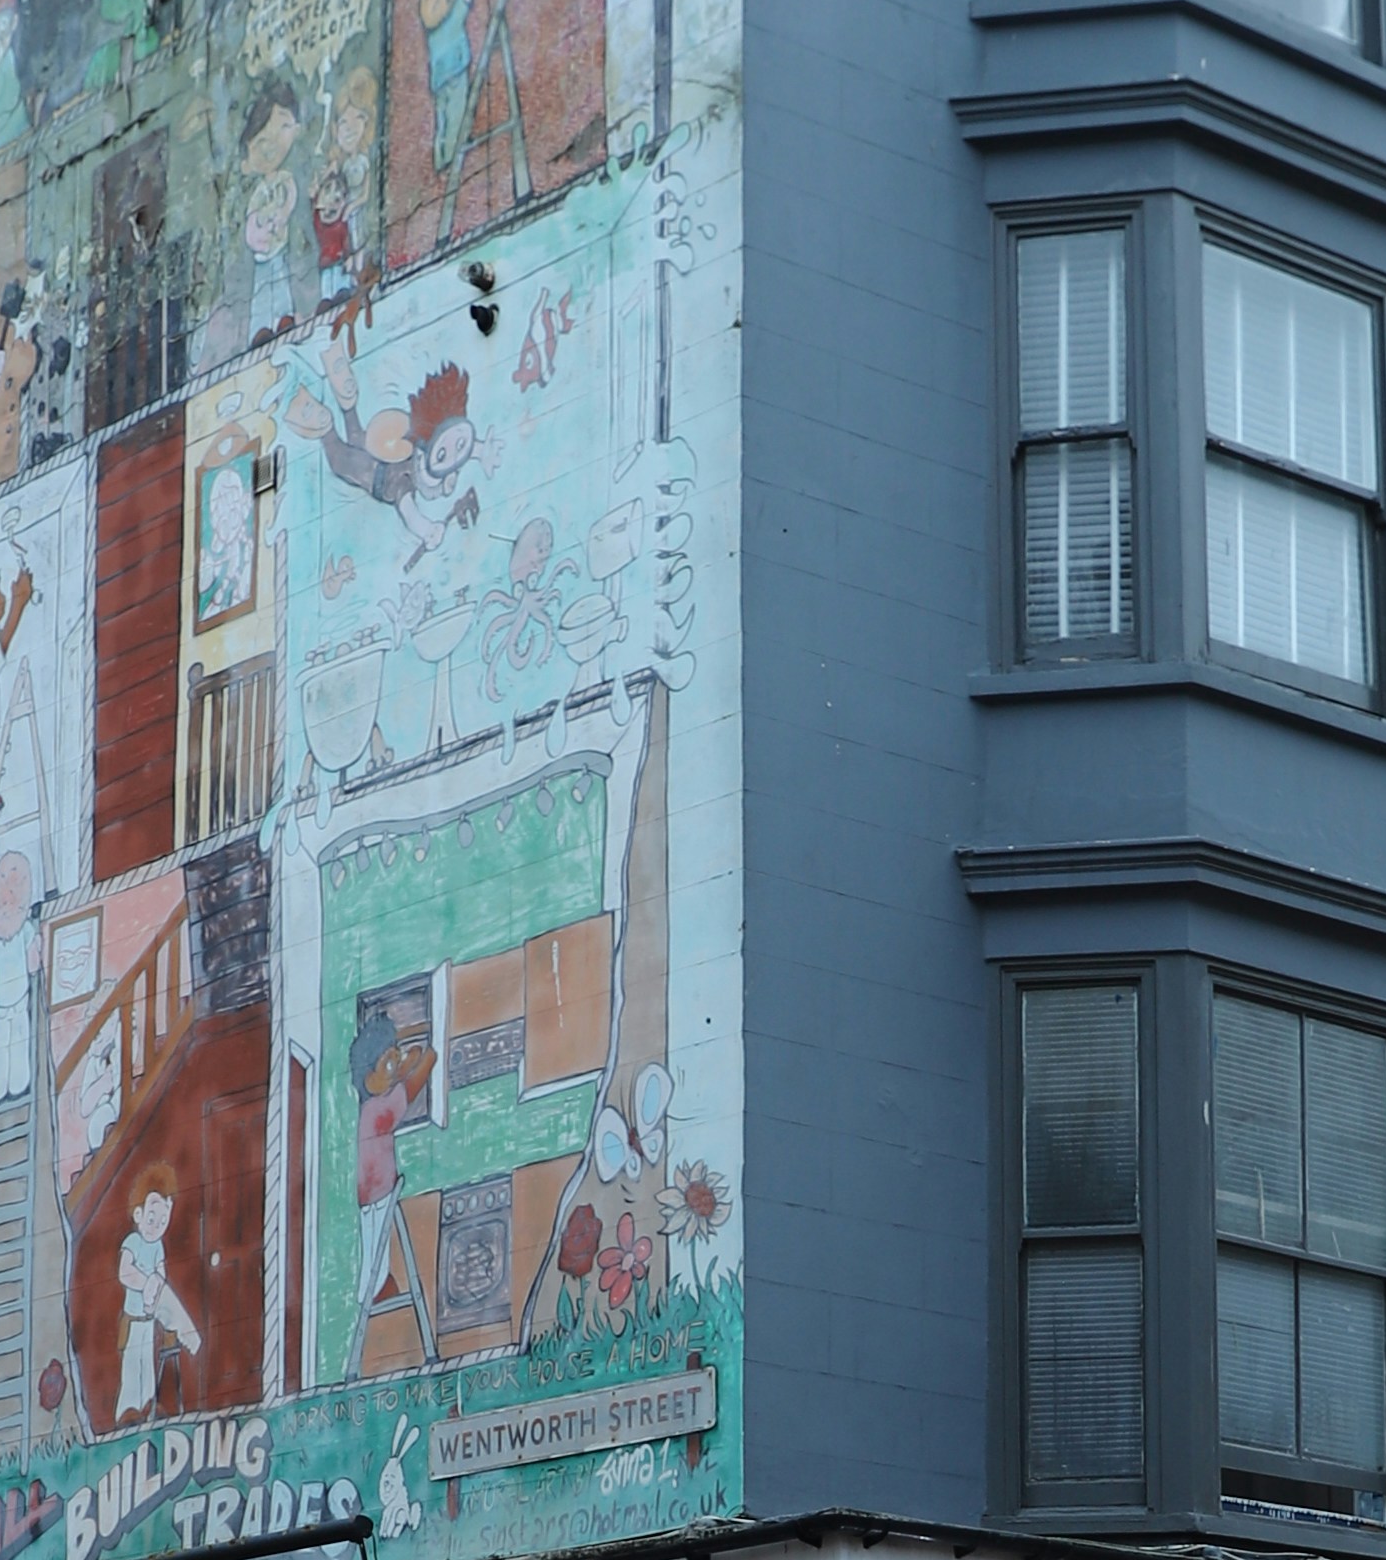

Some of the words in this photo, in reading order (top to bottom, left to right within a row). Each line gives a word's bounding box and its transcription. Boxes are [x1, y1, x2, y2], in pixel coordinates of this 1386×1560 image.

[281, 1394, 366, 1439] WORKING
[371, 1390, 399, 1413] TO
[405, 1381, 458, 1412] MAKE
[465, 1362, 521, 1401] YOUR
[527, 1348, 596, 1387] HOUSE
[605, 1343, 621, 1373] A
[439, 1406, 597, 1463] WENTWORTH
[608, 1386, 702, 1433] STREET
